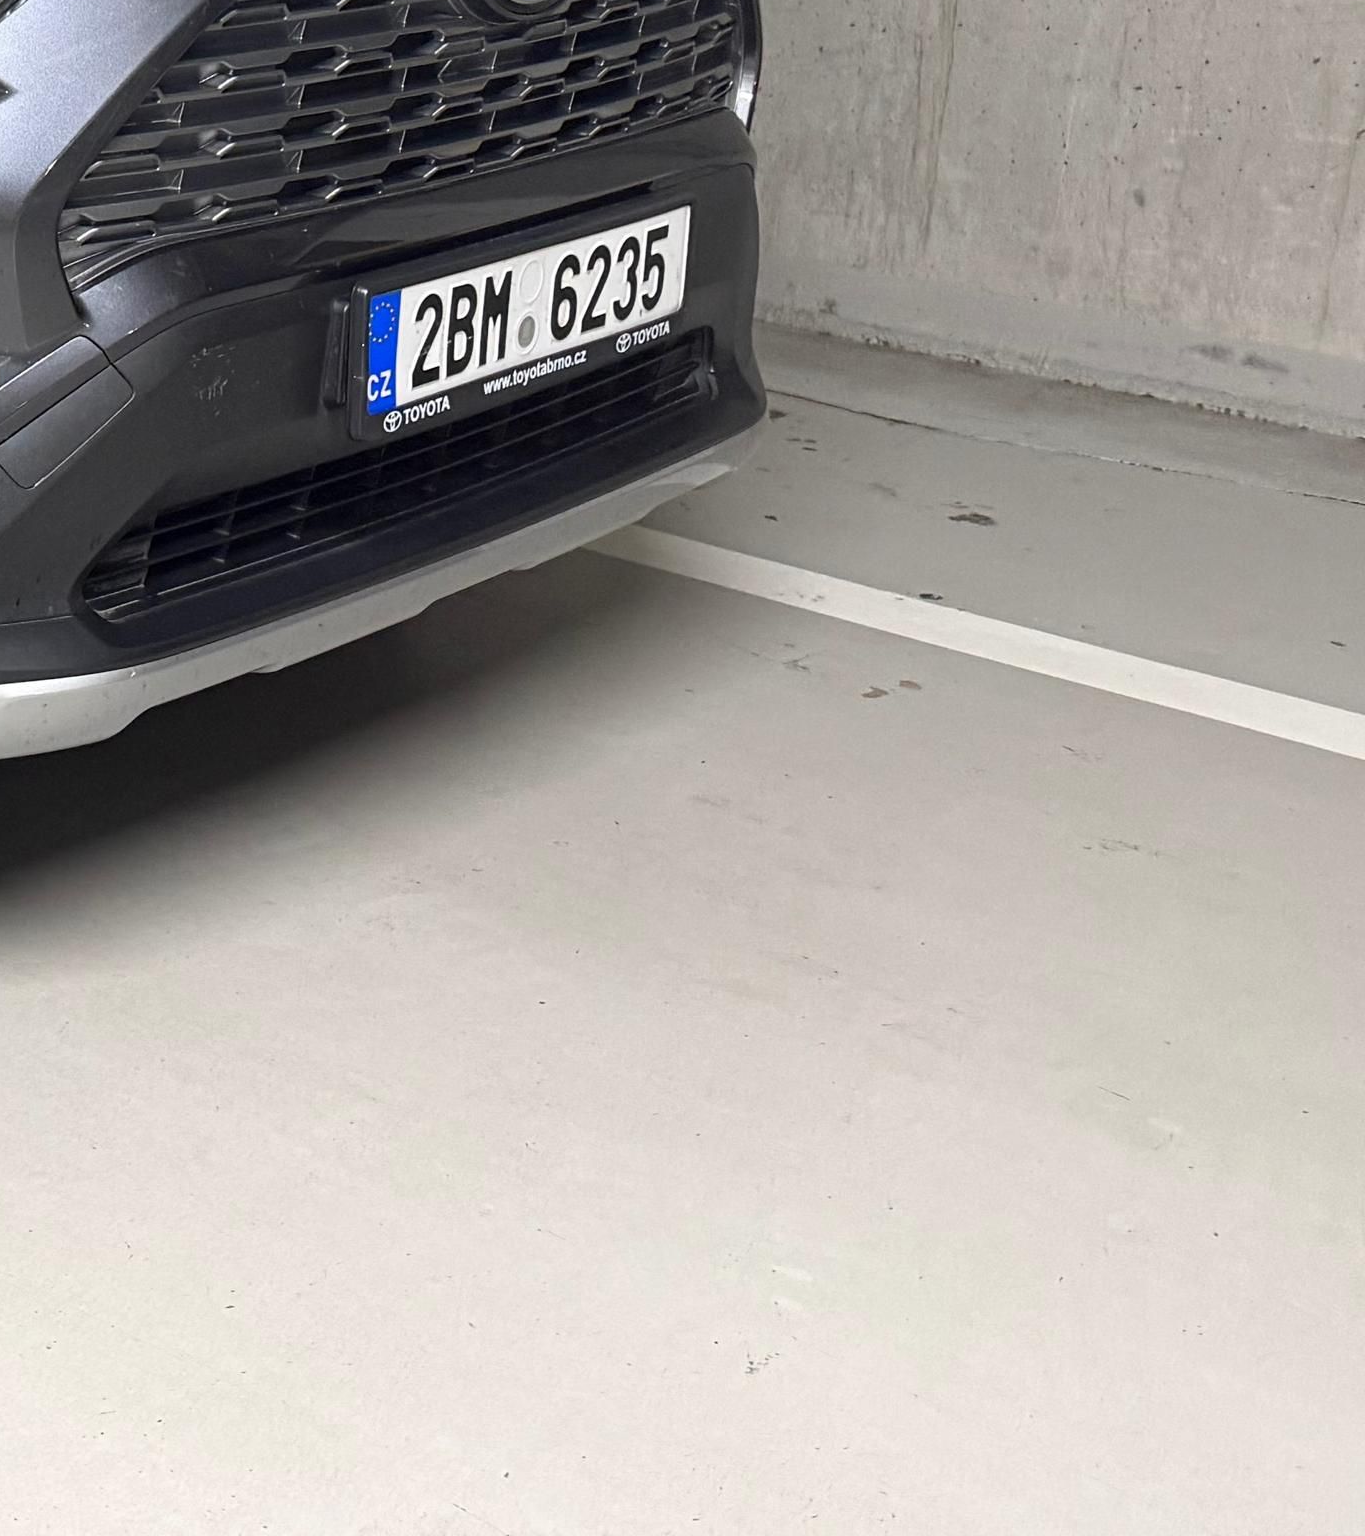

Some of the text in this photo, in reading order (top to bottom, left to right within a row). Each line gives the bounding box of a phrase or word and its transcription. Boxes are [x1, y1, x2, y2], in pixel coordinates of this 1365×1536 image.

[411, 223, 671, 390] 2BM 6235
[632, 320, 671, 347] TOYOTA
[367, 369, 392, 402] CZ
[483, 349, 588, 395] www.toyotabrno.cz
[403, 395, 451, 425] TOYOTA
